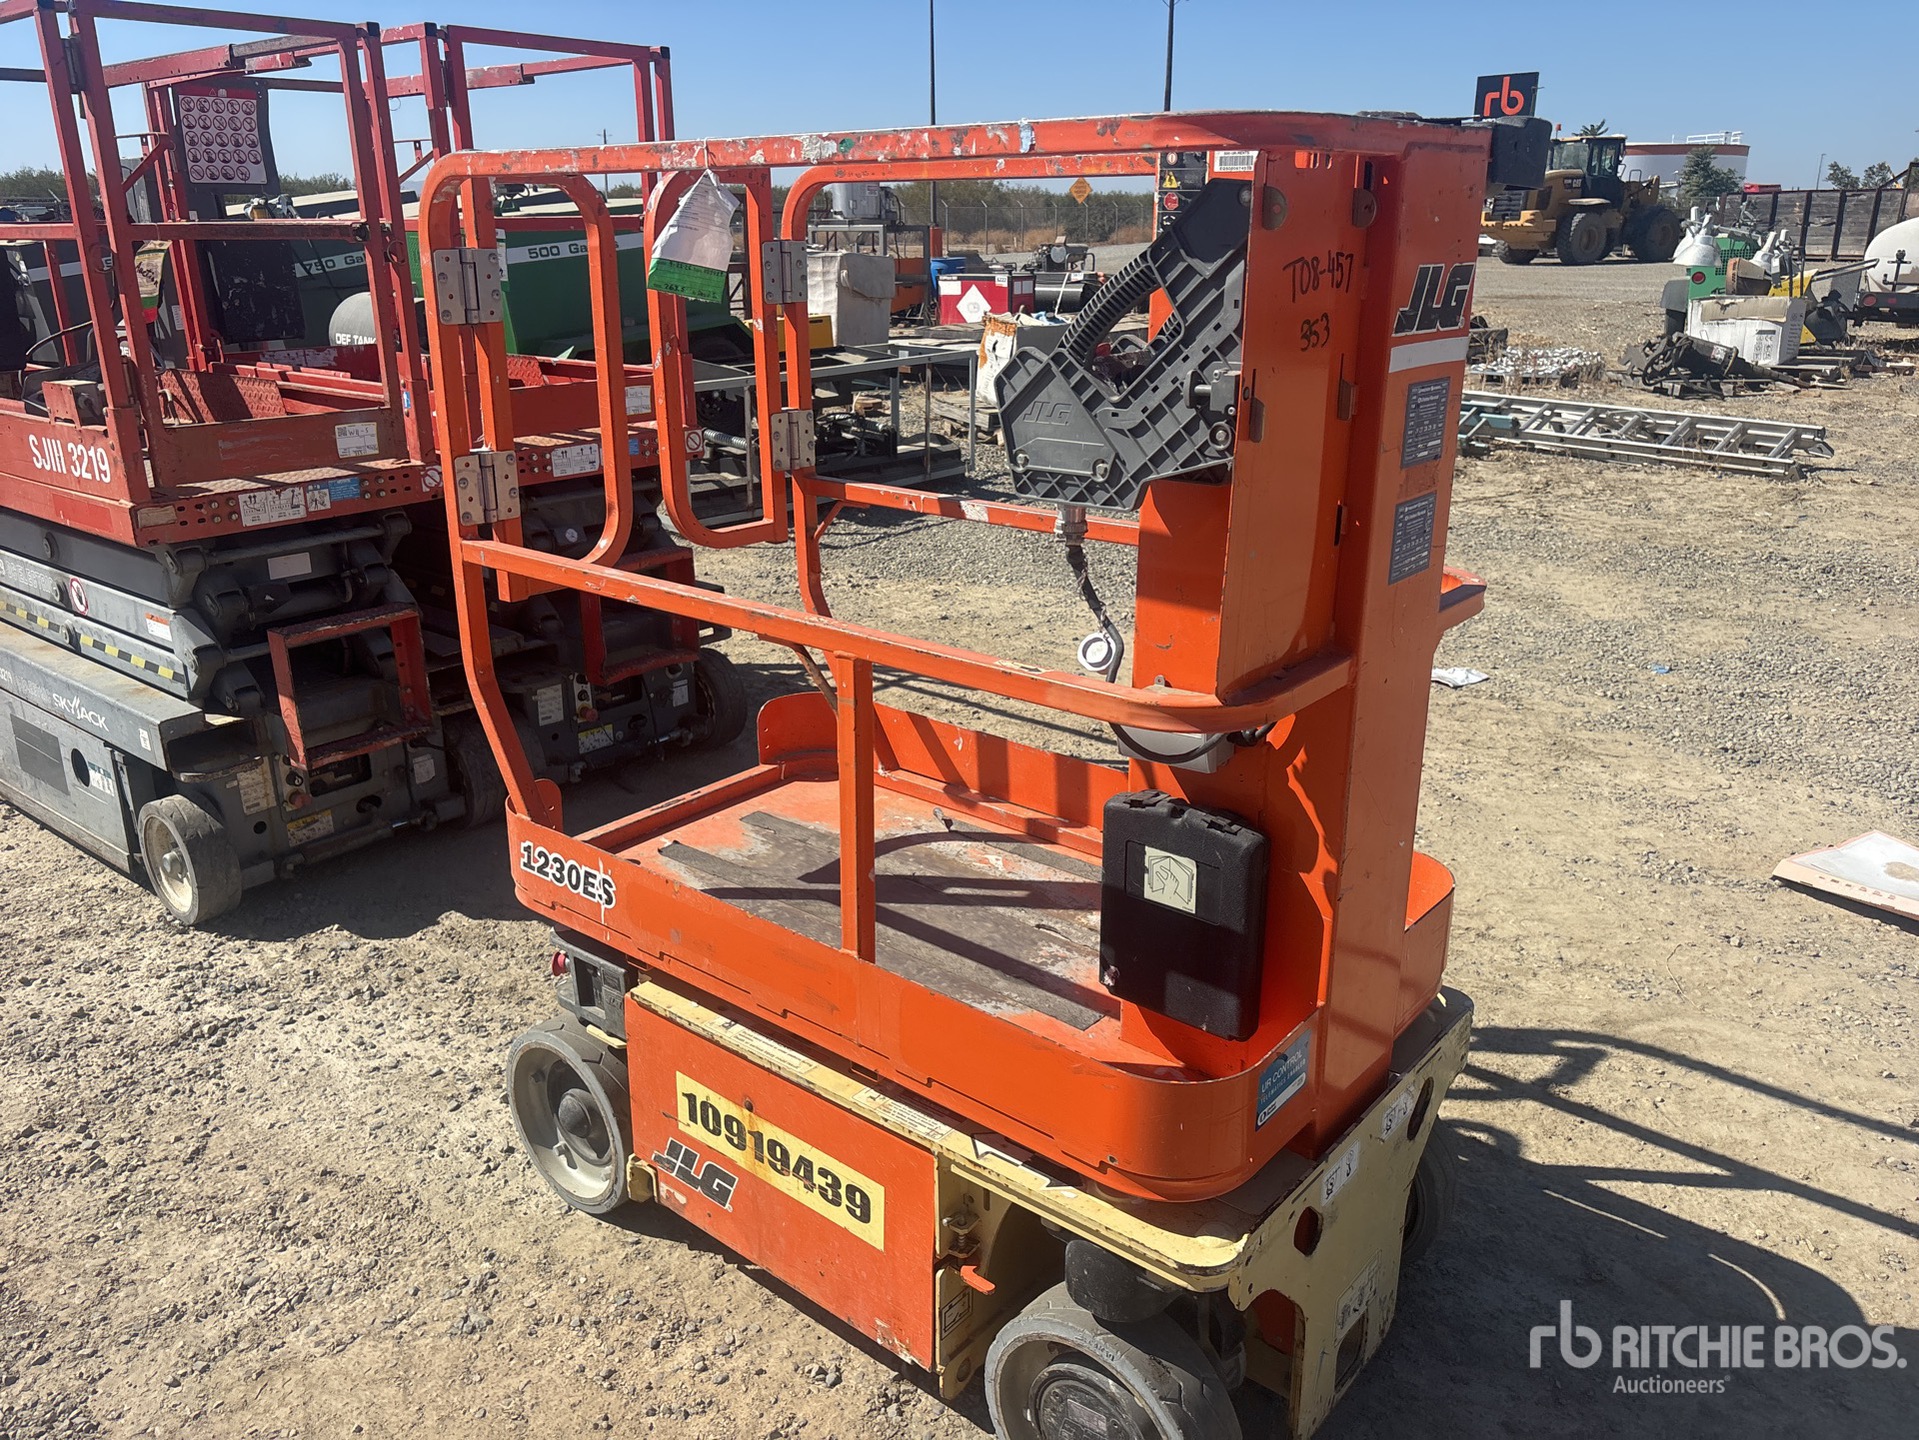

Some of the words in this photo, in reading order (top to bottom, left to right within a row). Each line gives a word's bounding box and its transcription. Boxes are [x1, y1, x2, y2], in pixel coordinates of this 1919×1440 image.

[1483, 76, 1525, 116] rb
[304, 258, 336, 273] 750
[528, 245, 561, 259] 500
[1283, 250, 1354, 303] T08-457
[1391, 262, 1476, 337] JLG
[335, 333, 351, 345] DEF
[1022, 400, 1072, 426] JLG
[67, 442, 111, 484] 3219
[52, 693, 110, 732] SKYJACK
[521, 841, 616, 908] 1230ES
[1261, 1077, 1272, 1093] UR
[1272, 1049, 1303, 1083] CONTROL
[651, 1137, 739, 1212] JLG
[682, 1092, 872, 1225] 10919439
